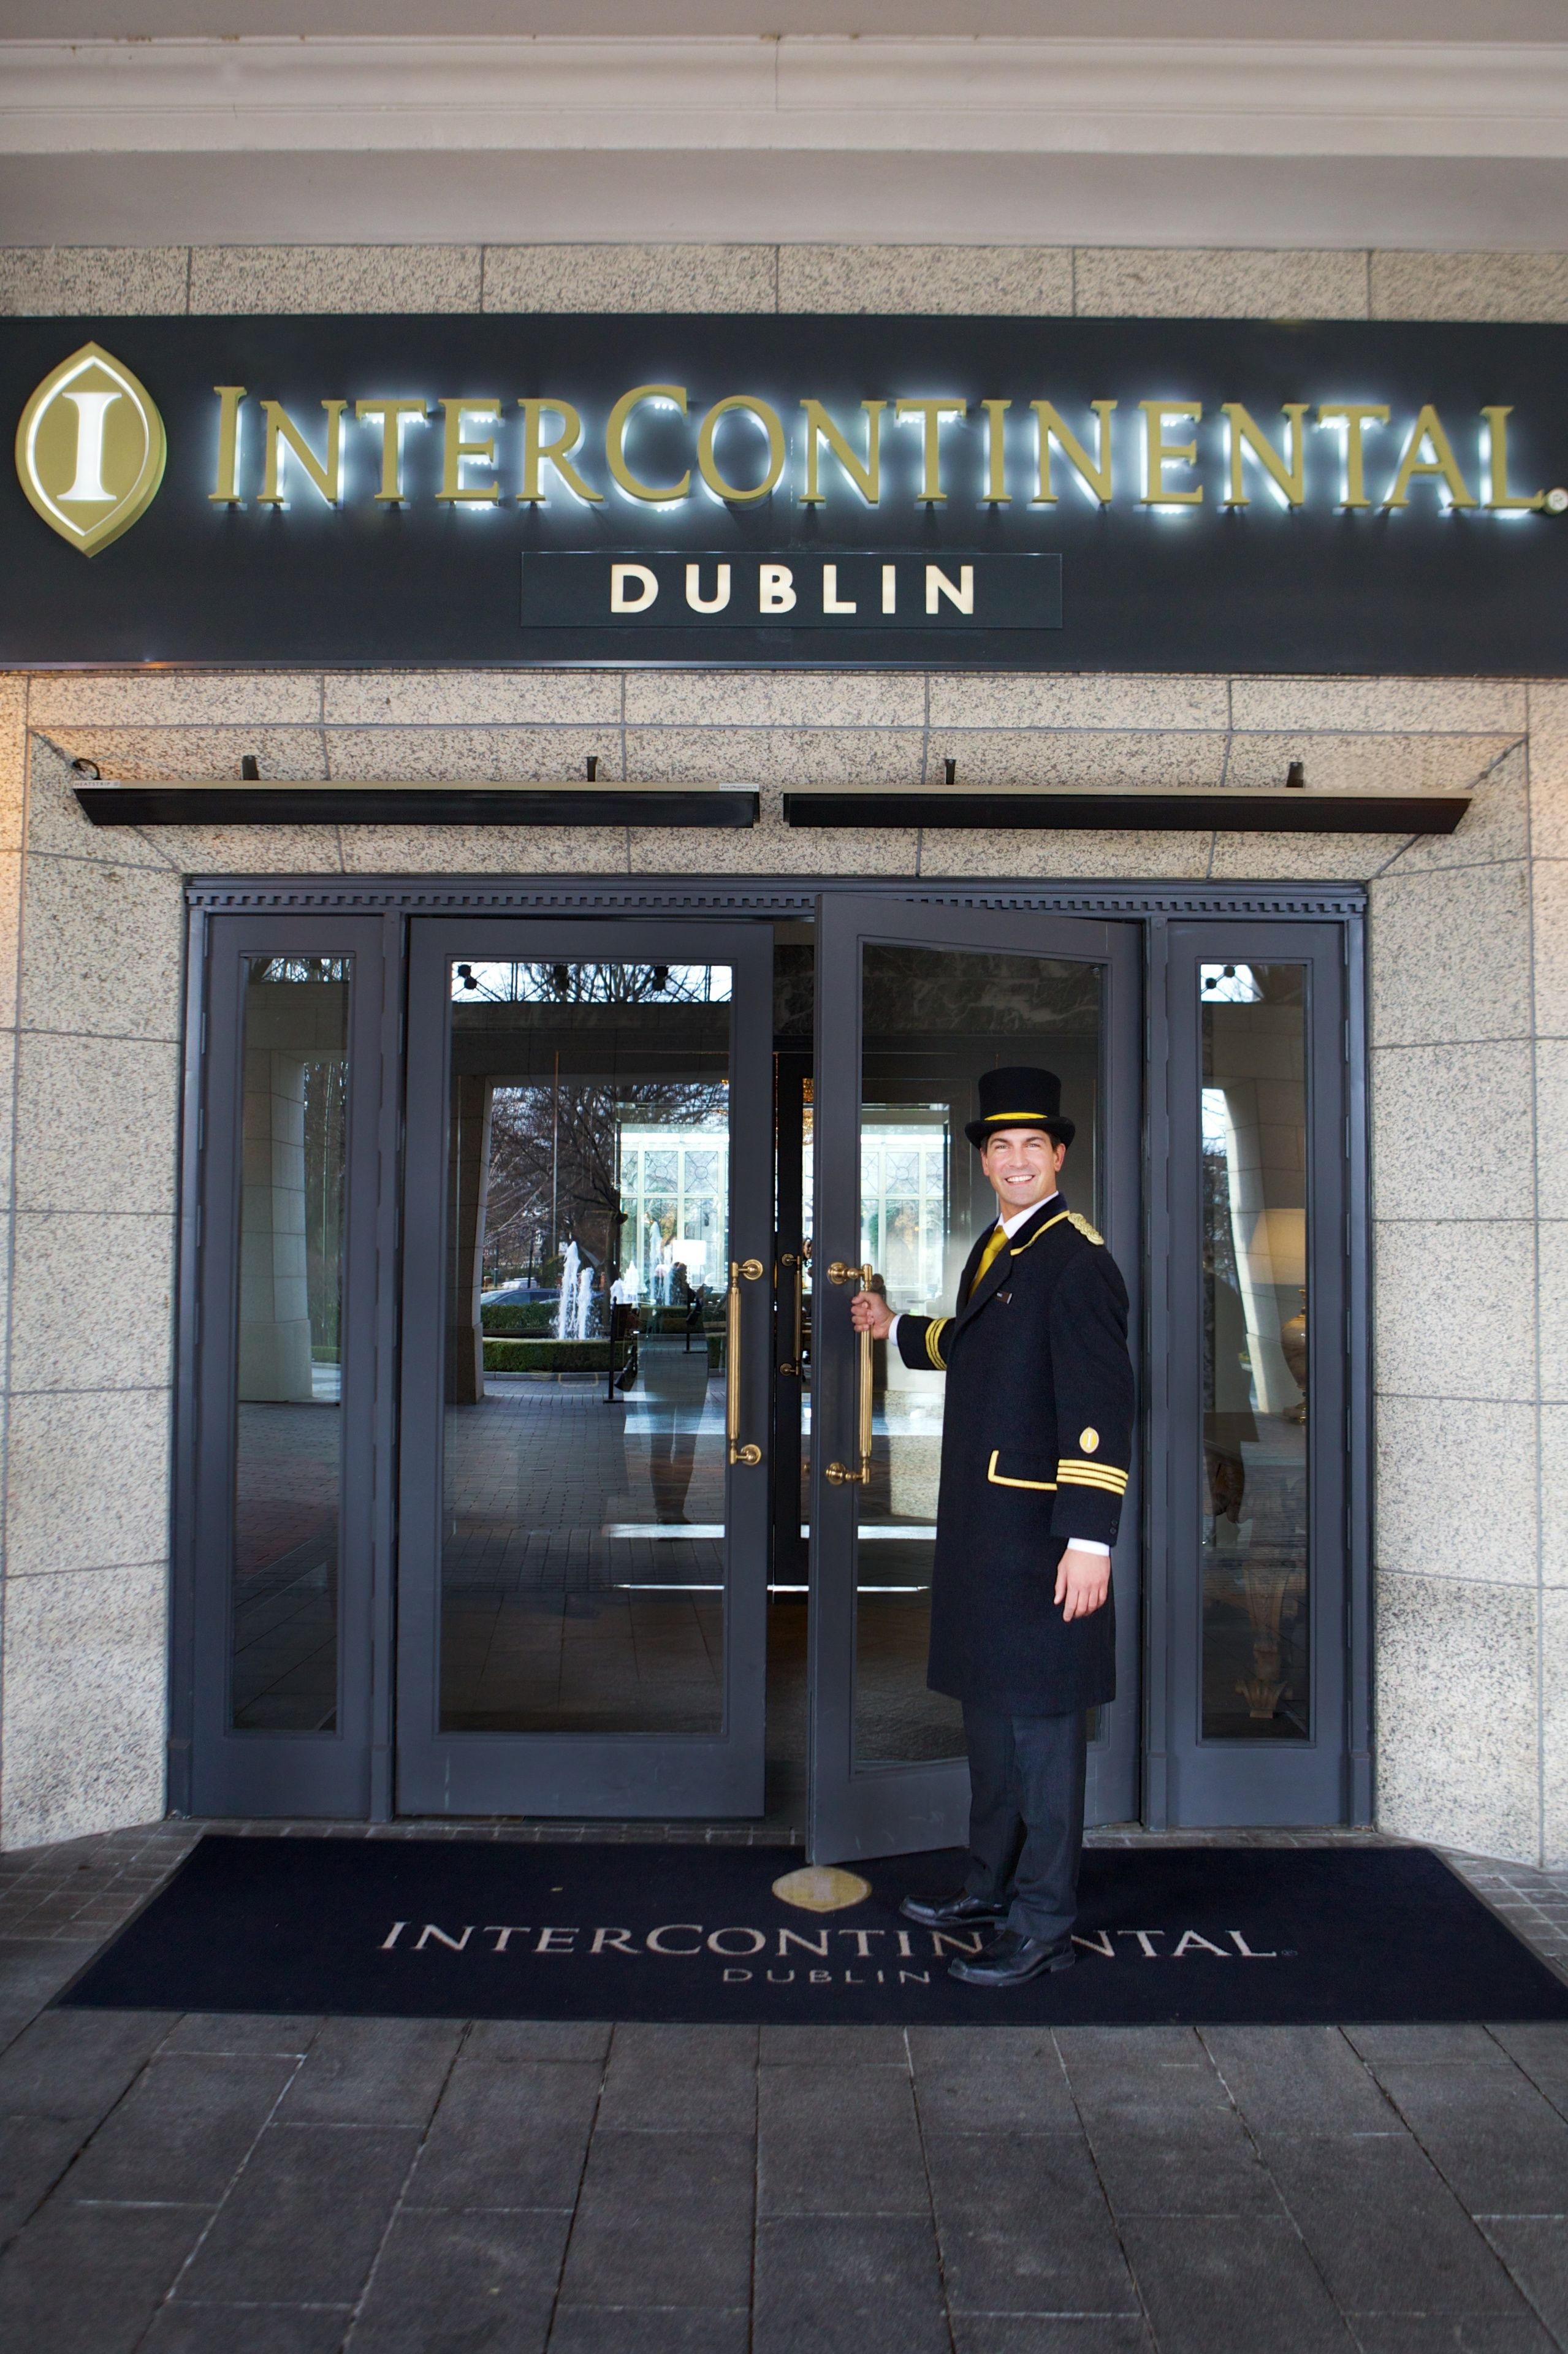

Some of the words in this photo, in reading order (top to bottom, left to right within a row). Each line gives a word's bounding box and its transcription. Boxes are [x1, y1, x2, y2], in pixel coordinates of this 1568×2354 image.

[57, 391, 123, 501] I
[207, 384, 1543, 510] INTERCONTINENTAL
[611, 564, 974, 614] DUBLIN
[378, 1921, 1277, 1957] INTERCONTINNTAL
[723, 1968, 930, 1984] DUBLIN
